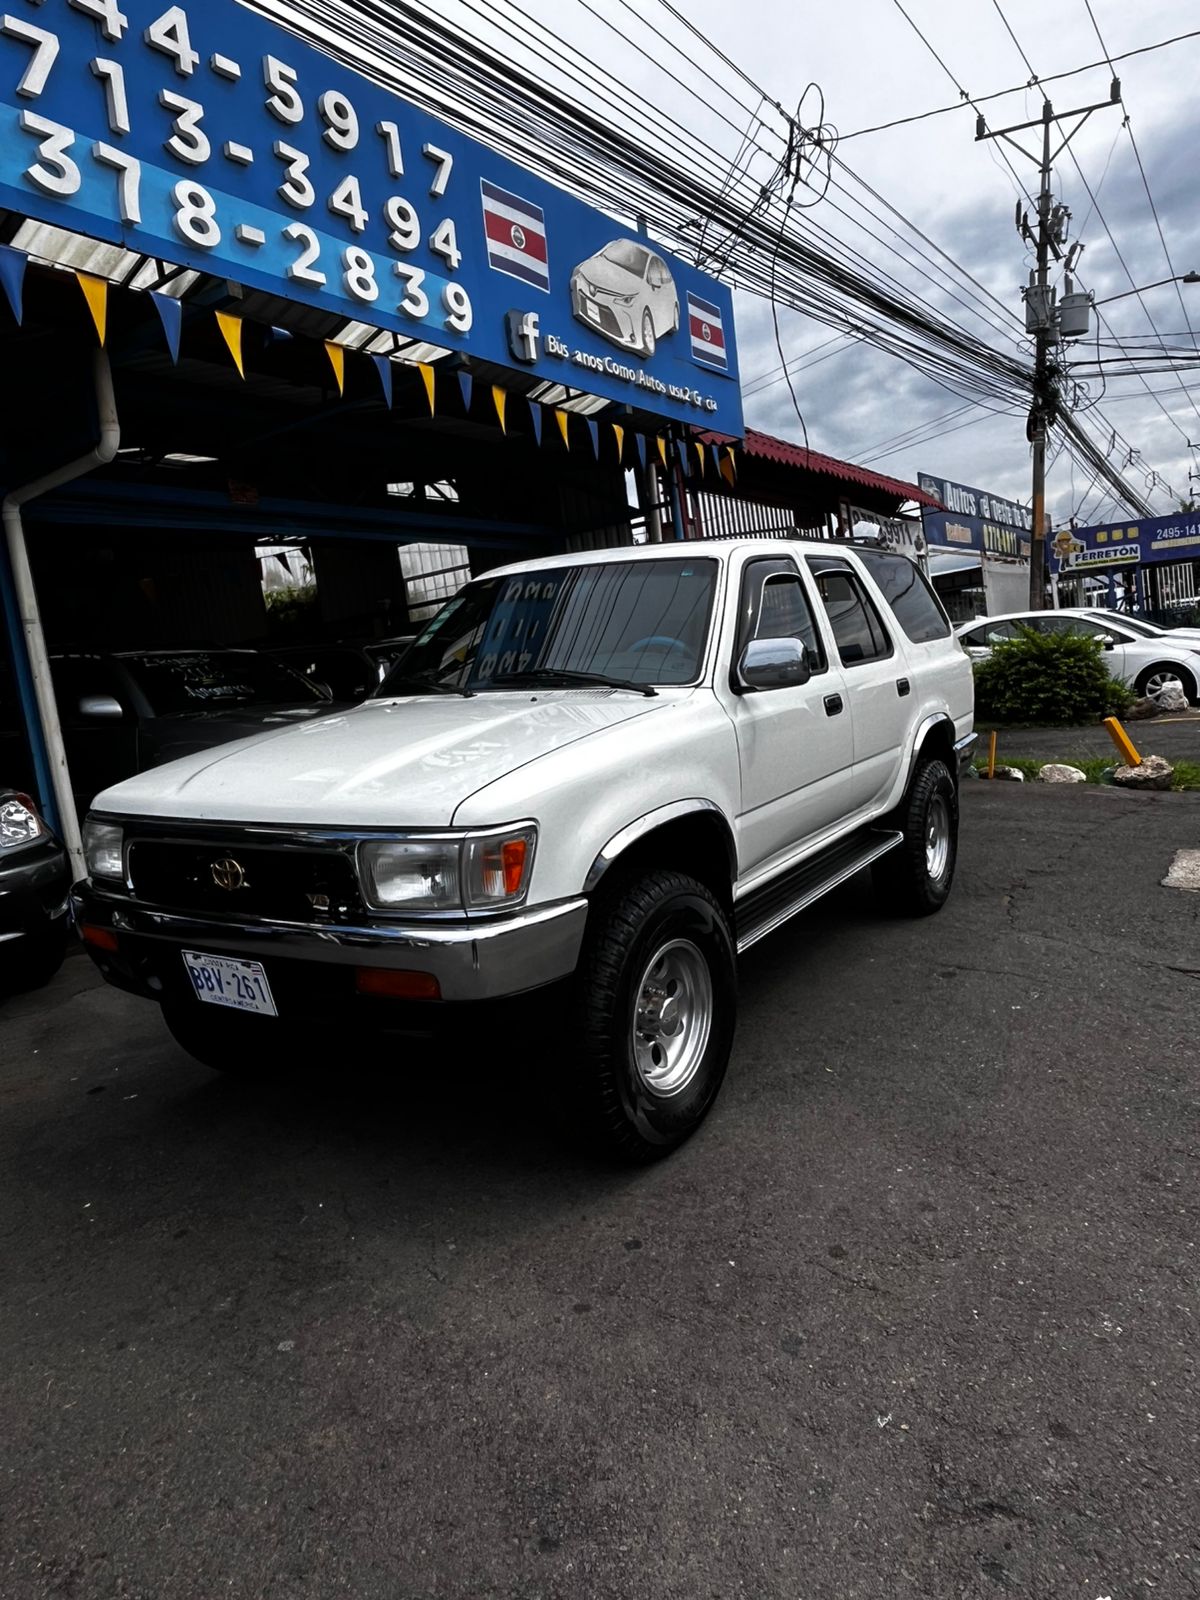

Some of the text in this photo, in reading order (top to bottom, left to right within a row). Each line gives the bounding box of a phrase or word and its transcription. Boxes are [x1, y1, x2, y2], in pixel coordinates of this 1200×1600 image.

[20, 109, 472, 333] 378-2839
[604, 357, 635, 381] Como
[637, 369, 666, 394] Autos
[944, 482, 976, 516] Autos
[1074, 546, 1139, 562] FERRETÓN
[188, 965, 267, 1003] BBV-261
